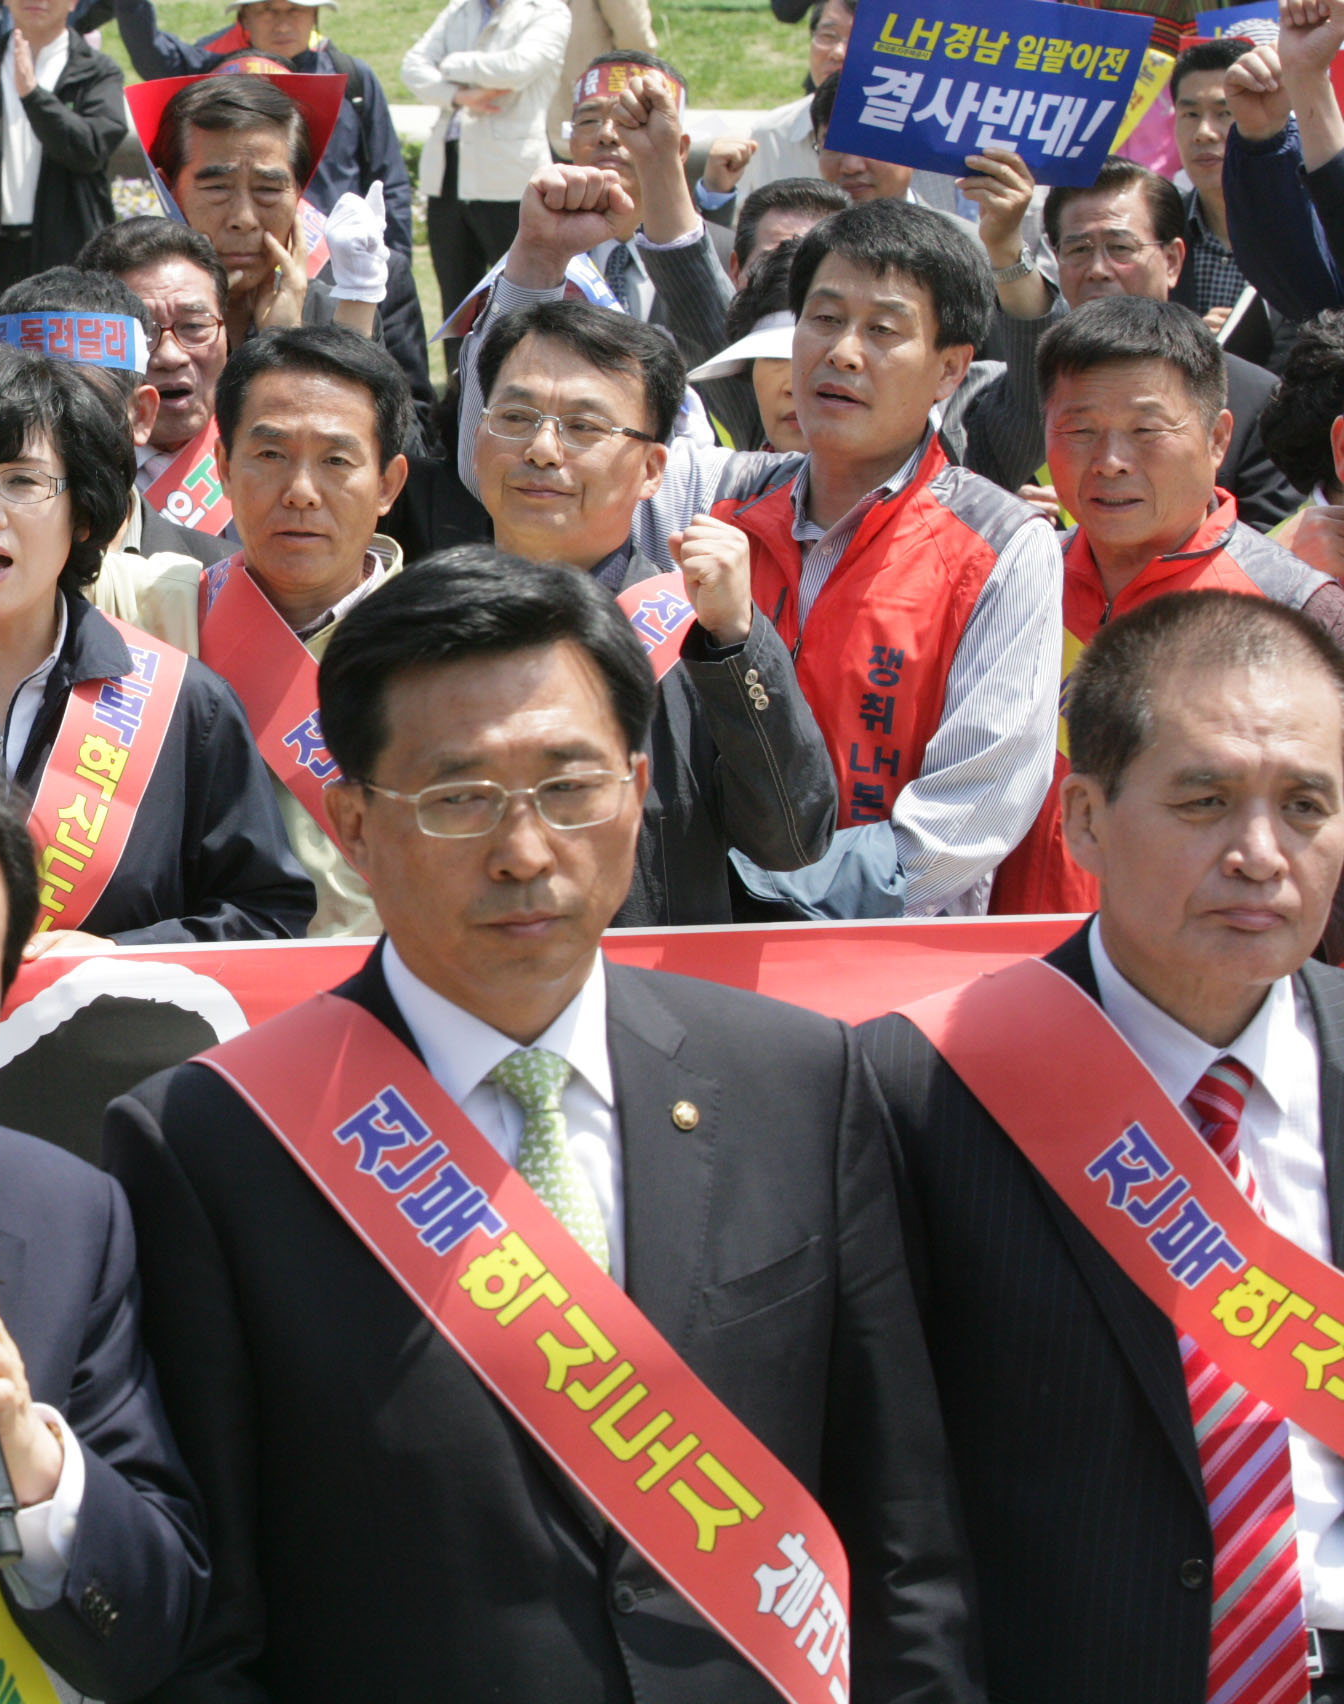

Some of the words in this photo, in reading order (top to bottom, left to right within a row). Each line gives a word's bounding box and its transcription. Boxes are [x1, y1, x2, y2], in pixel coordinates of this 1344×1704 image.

[879, 13, 943, 51] LH
[944, 22, 1010, 65] 경남
[1015, 34, 1130, 82] 일괄이전
[858, 66, 1116, 158] 결사반대!
[19, 317, 128, 362] 돌려달라
